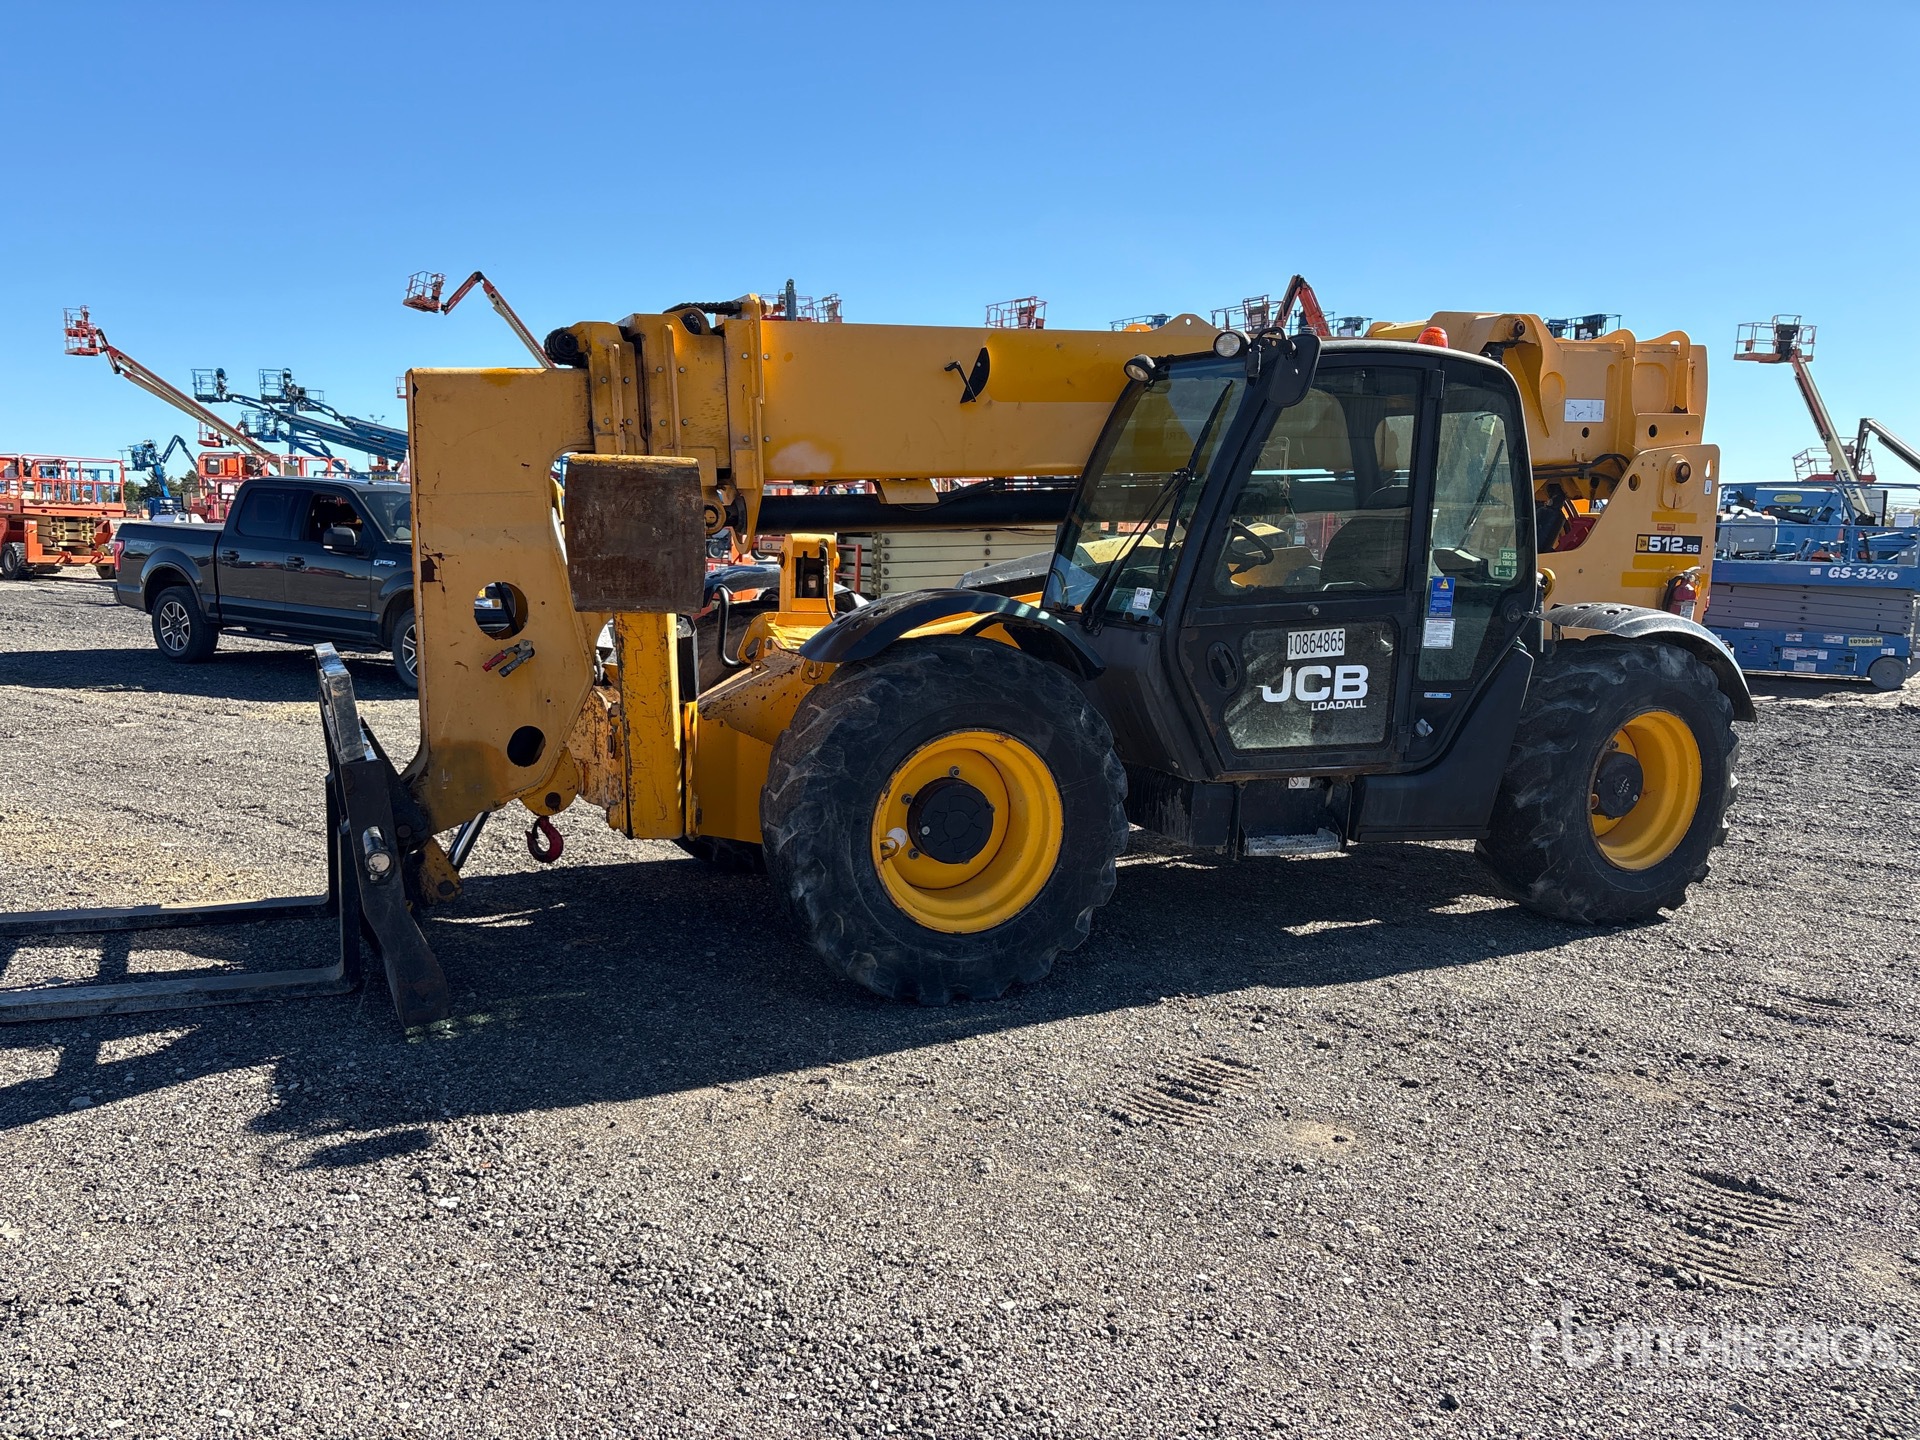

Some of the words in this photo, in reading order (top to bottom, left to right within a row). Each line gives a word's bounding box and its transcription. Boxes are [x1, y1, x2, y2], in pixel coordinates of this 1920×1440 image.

[1288, 631, 1344, 655] 10864865
[1261, 665, 1369, 703] JCB
[1311, 700, 1367, 711] LOADALL
